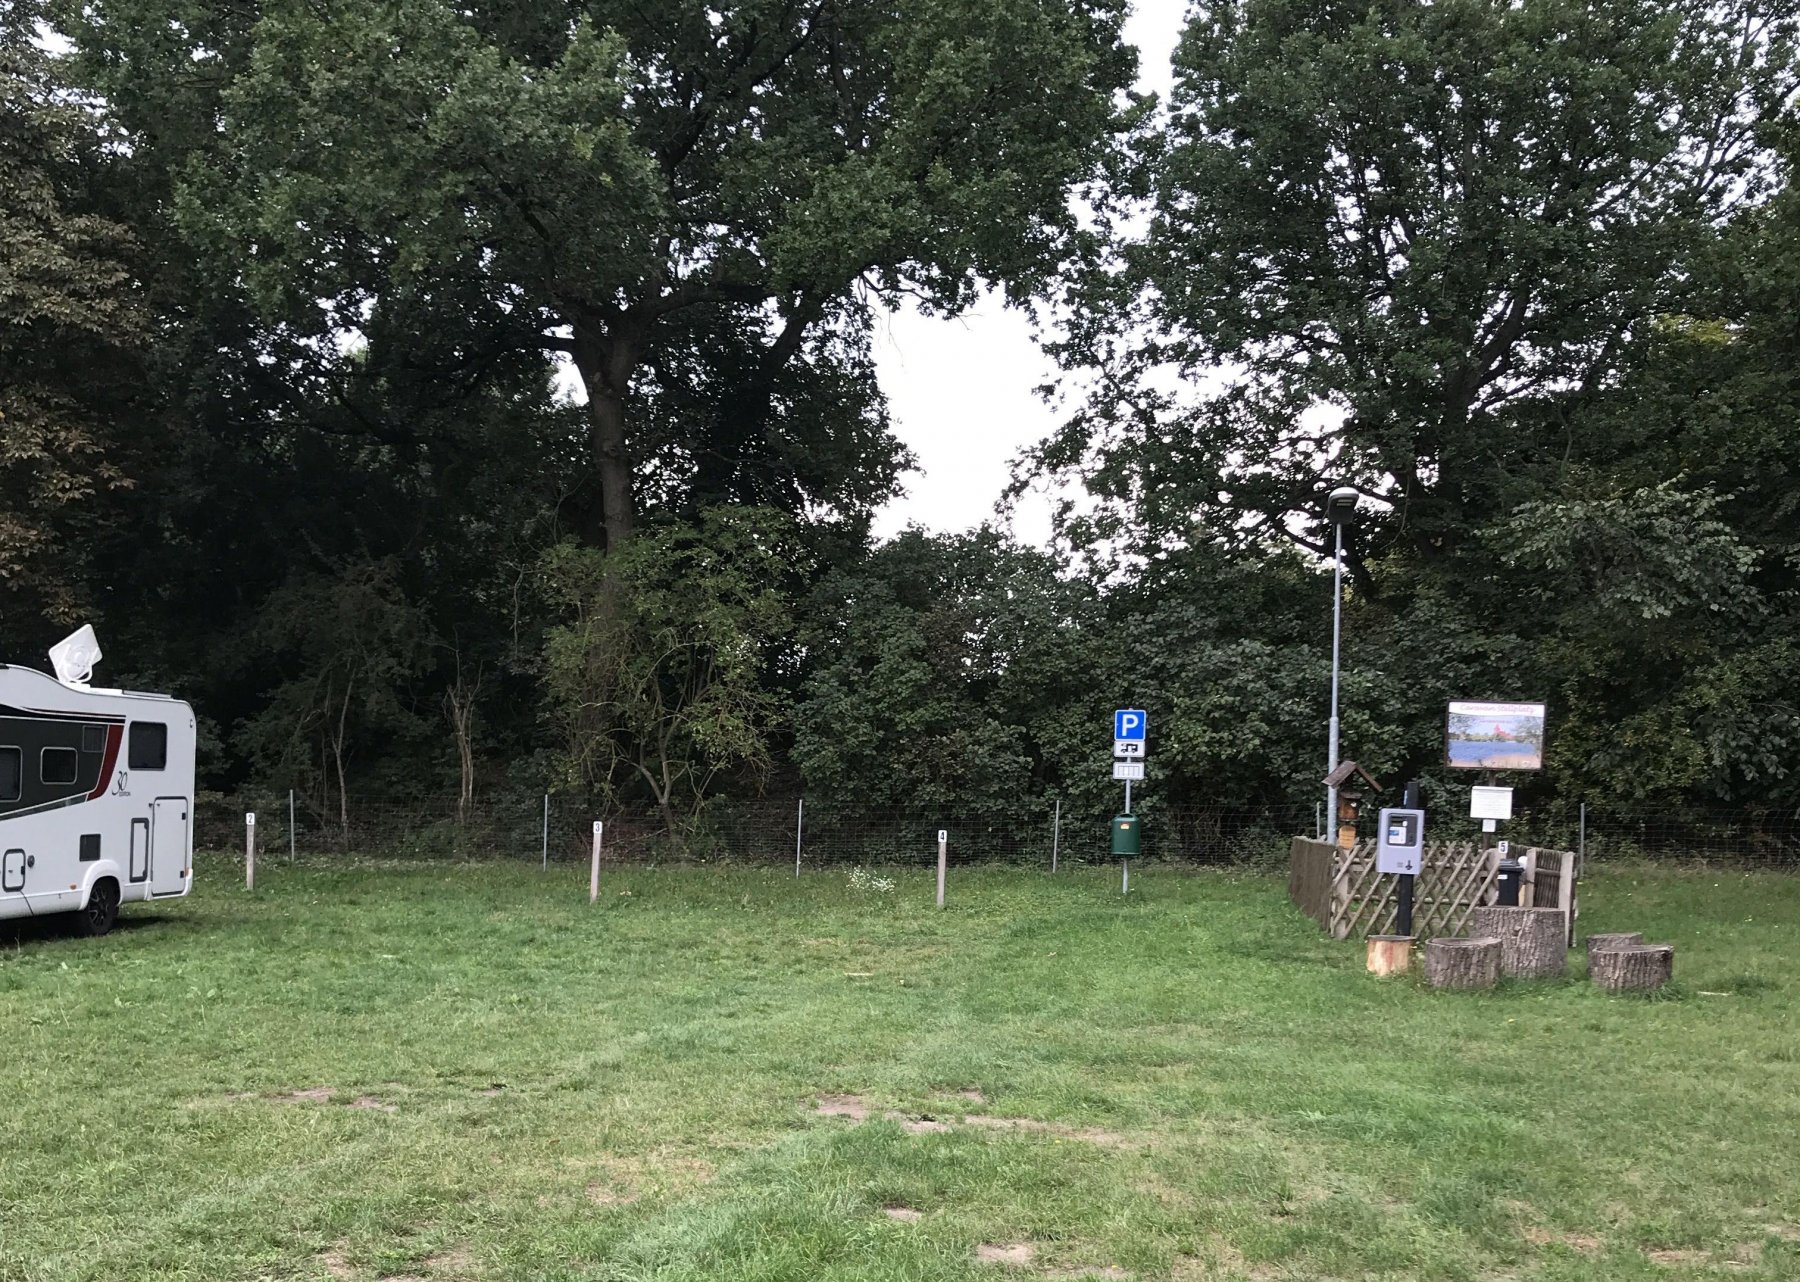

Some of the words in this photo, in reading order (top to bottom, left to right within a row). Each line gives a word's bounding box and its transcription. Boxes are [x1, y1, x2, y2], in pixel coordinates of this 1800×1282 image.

[1122, 714, 1139, 736] P
[111, 770, 128, 795] 30
[248, 814, 253, 823] 2
[595, 823, 600, 832] 3
[940, 831, 945, 841] 4
[1500, 842, 1506, 852] 5
